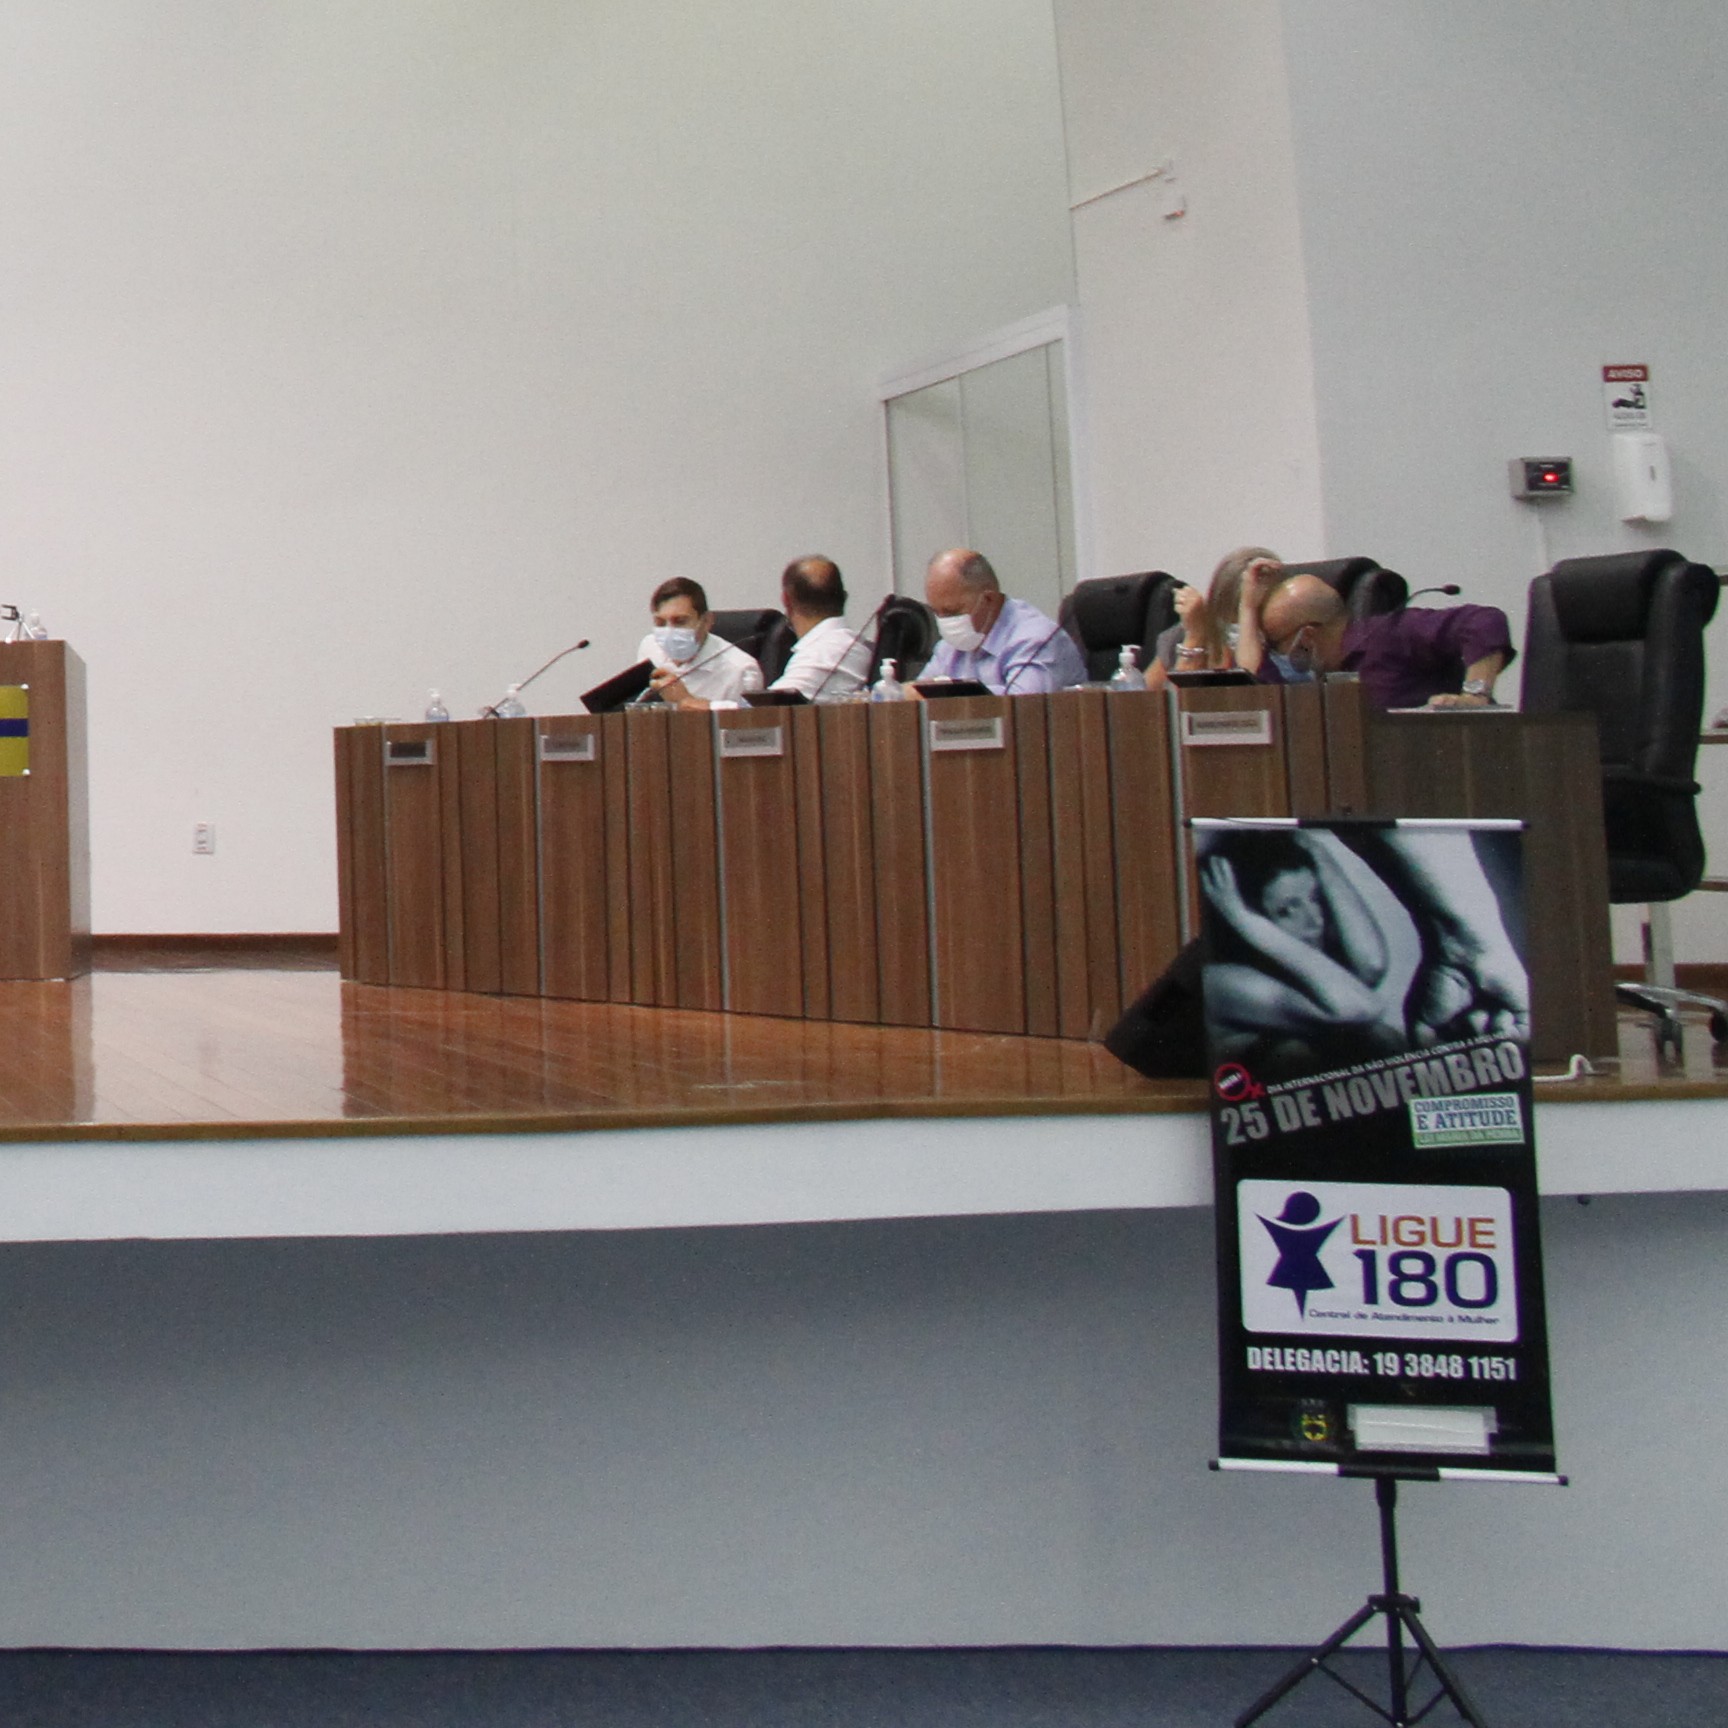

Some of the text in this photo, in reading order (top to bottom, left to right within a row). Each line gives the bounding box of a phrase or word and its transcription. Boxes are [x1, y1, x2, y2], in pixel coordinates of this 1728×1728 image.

[1220, 1041, 1524, 1146] 25 DE NOVEMBRO
[1415, 1096, 1514, 1112] COMPROMISSO
[1417, 1109, 1517, 1130] E ATITUDE
[1350, 1214, 1496, 1249] LIGUE
[1353, 1248, 1498, 1309] 180
[1246, 1346, 1516, 1381] DELEGACIA: 19 3848 1151
